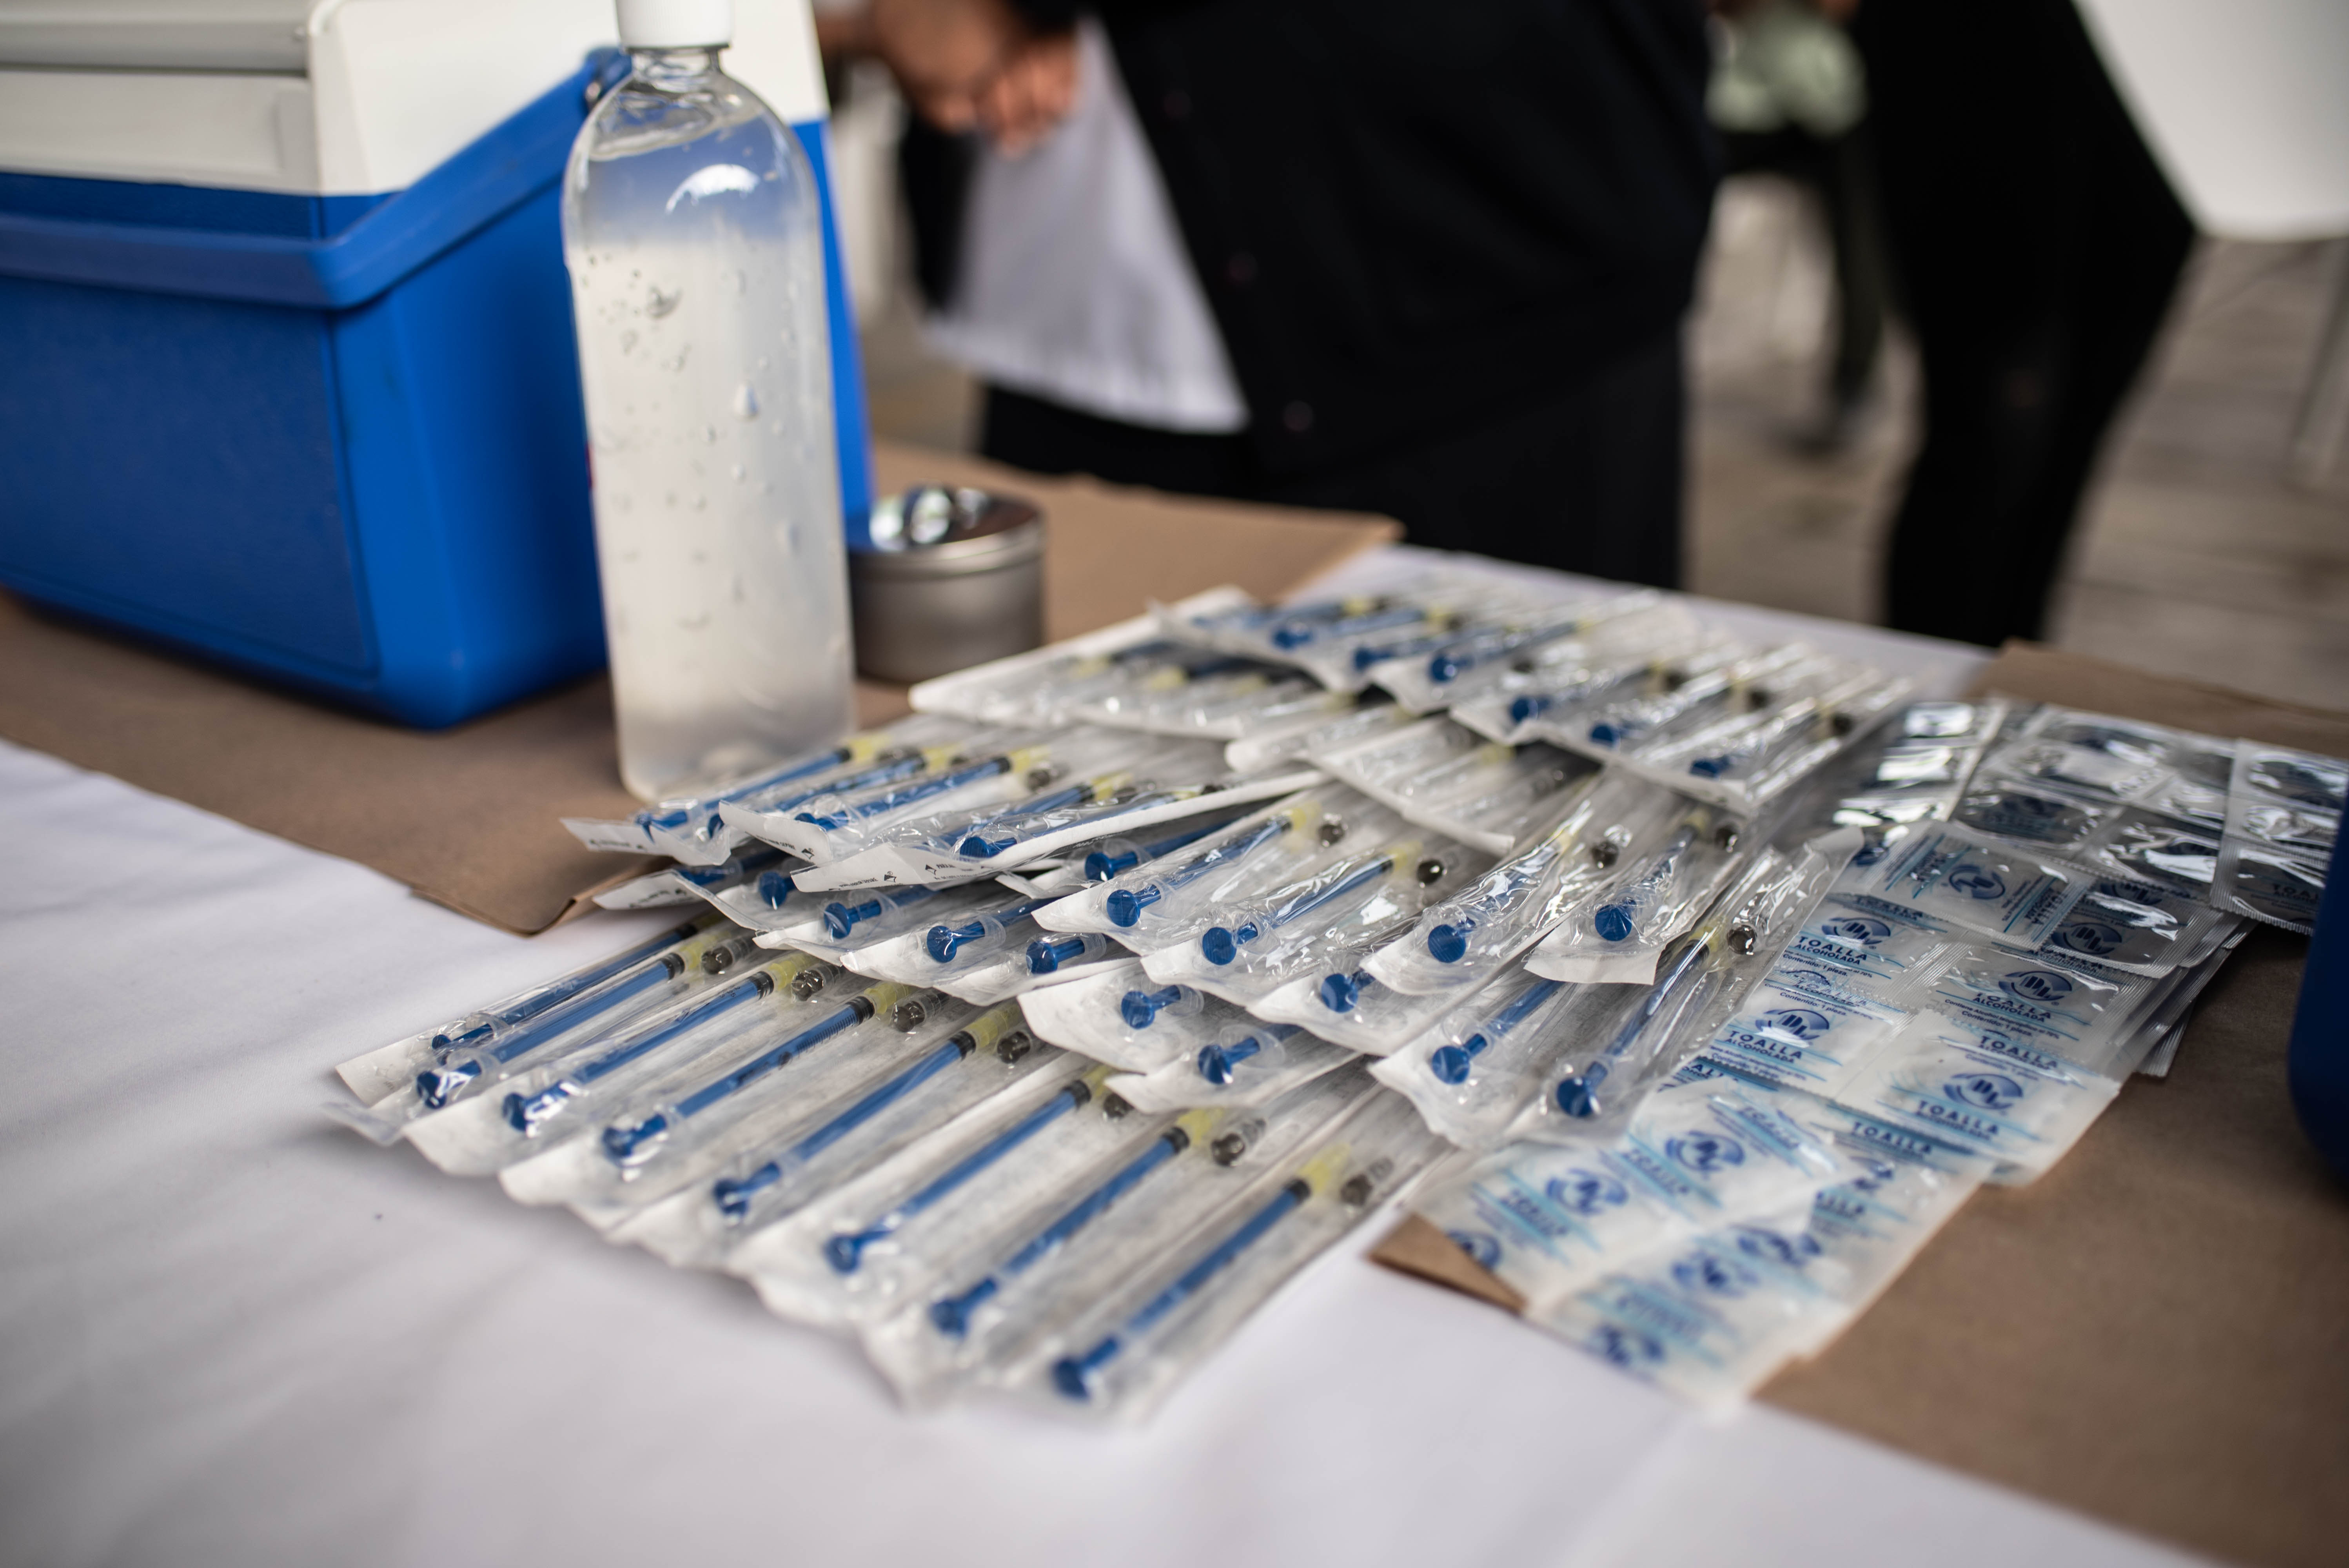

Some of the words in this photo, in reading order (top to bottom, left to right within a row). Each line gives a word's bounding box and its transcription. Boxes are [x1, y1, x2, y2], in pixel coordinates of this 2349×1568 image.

[1795, 944, 1861, 965] ALCOHOLADA
[1799, 936, 1868, 960] TOALLA
[1783, 953, 1821, 968] Contenido:
[1826, 966, 1848, 977] pieza.
[1780, 992, 1819, 1007] Contenido:
[1825, 1005, 1847, 1016] pieza.
[1945, 999, 1973, 1011] Contiene
[1973, 997, 2045, 1023] ALCOHOLADA
[1977, 992, 2052, 1019] TOALLA
[1962, 1010, 2004, 1027] Contenido:
[2010, 1025, 2033, 1038] pieza.
[1725, 1038, 1795, 1063] ALCOHOLADA
[1729, 1030, 1803, 1060] TOALLA
[1980, 1035, 2058, 1068] TOALLA
[1918, 1100, 1999, 1134] TOALLA
[1854, 1121, 1932, 1154] TOALLA
